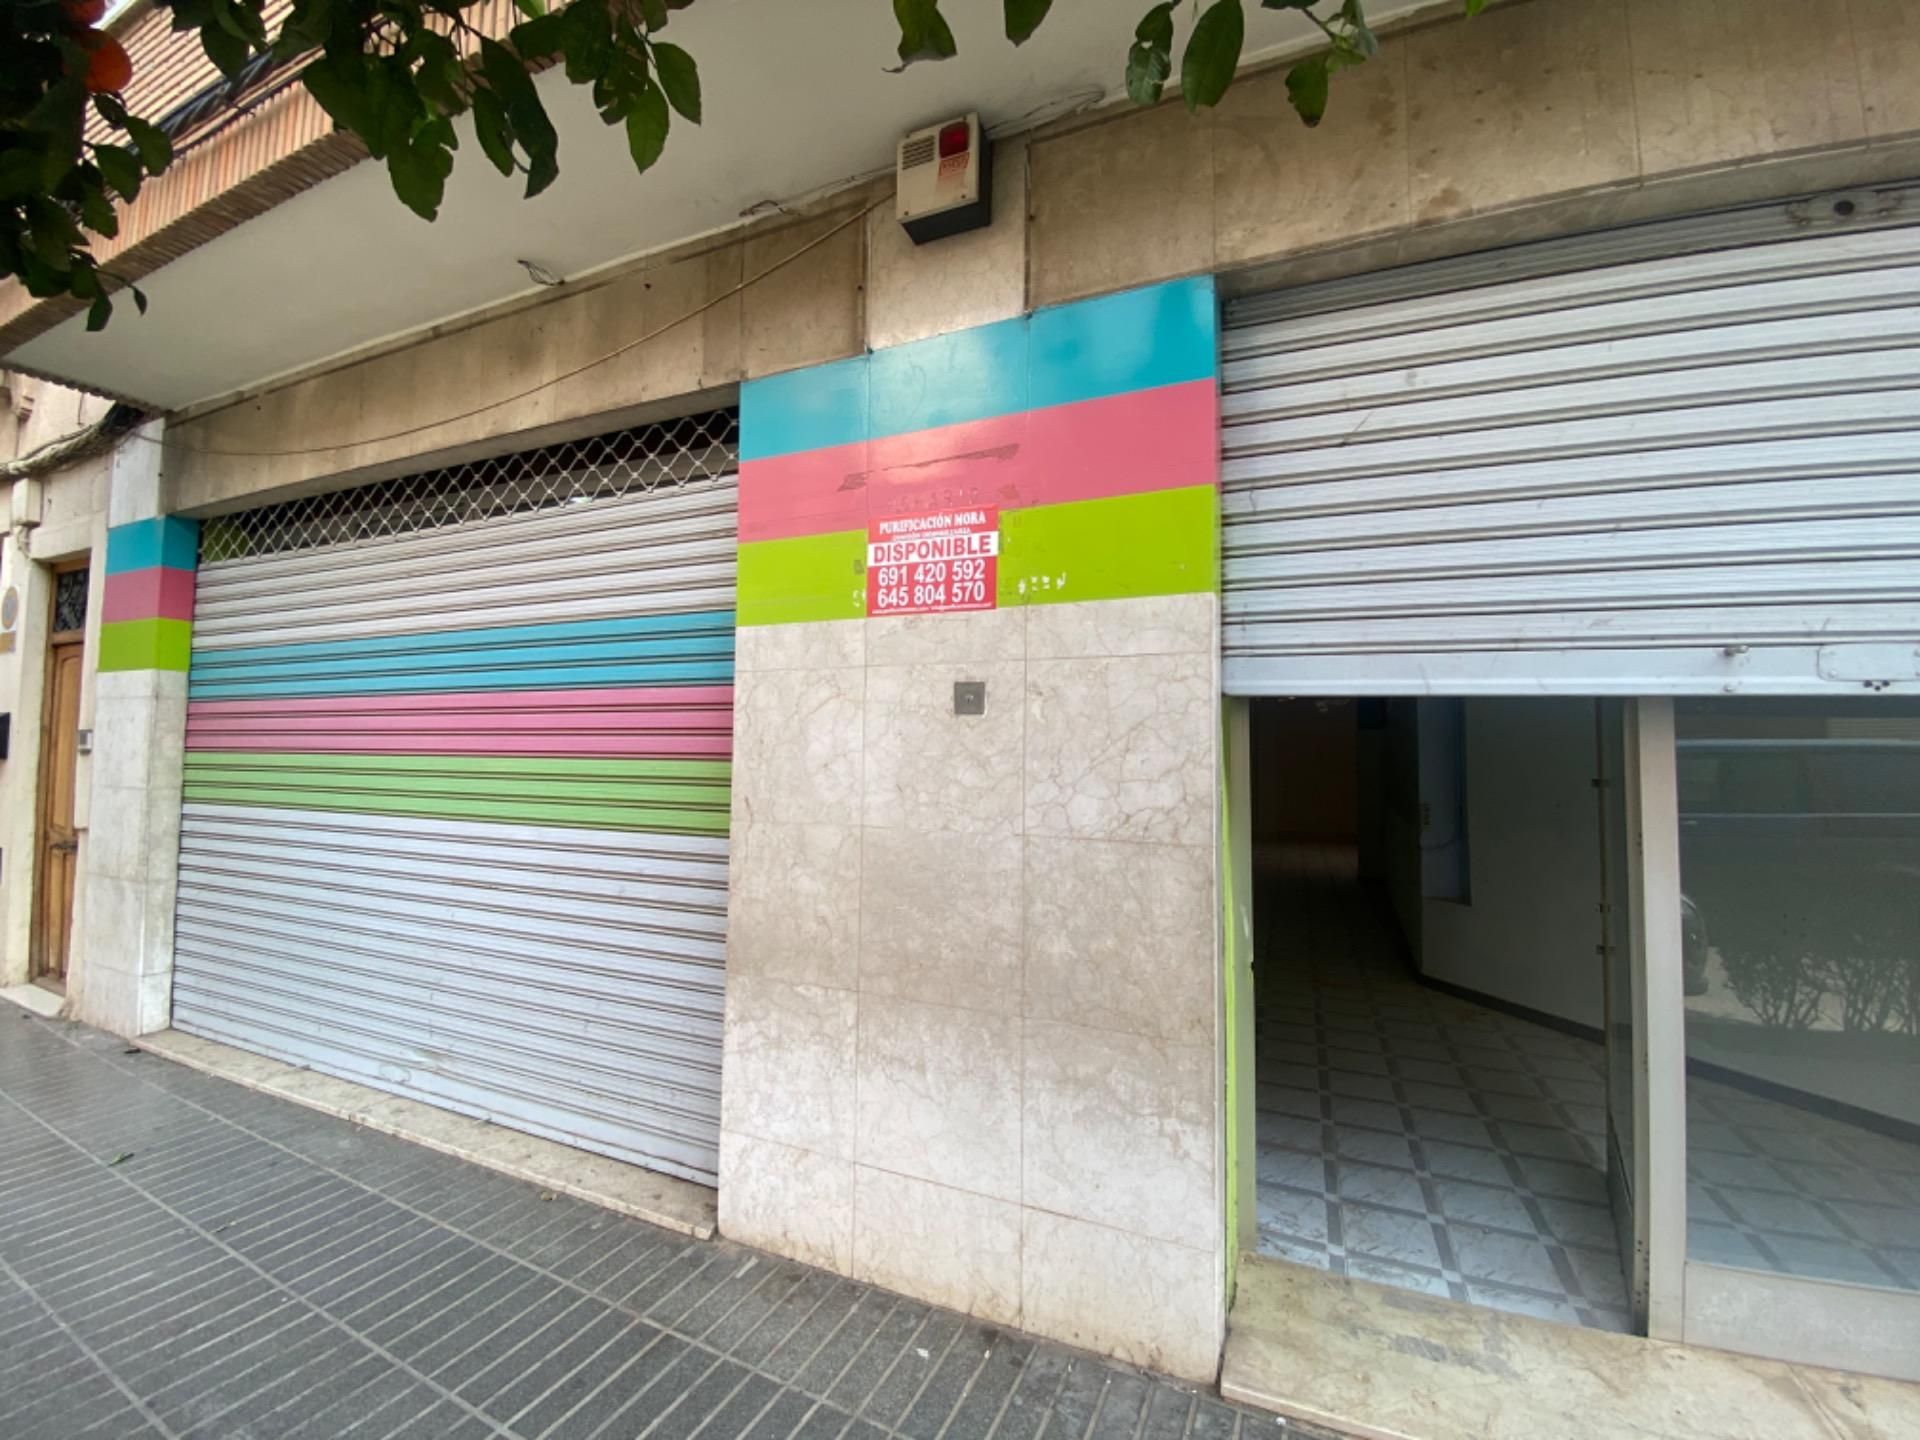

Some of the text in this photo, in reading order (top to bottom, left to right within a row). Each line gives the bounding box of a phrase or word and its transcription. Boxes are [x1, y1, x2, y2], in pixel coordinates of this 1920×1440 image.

[954, 511, 986, 526] MORA
[874, 535, 991, 563] DISPONIBLE
[878, 559, 985, 587] 691 420 592
[877, 581, 985, 608] 645 804 570
